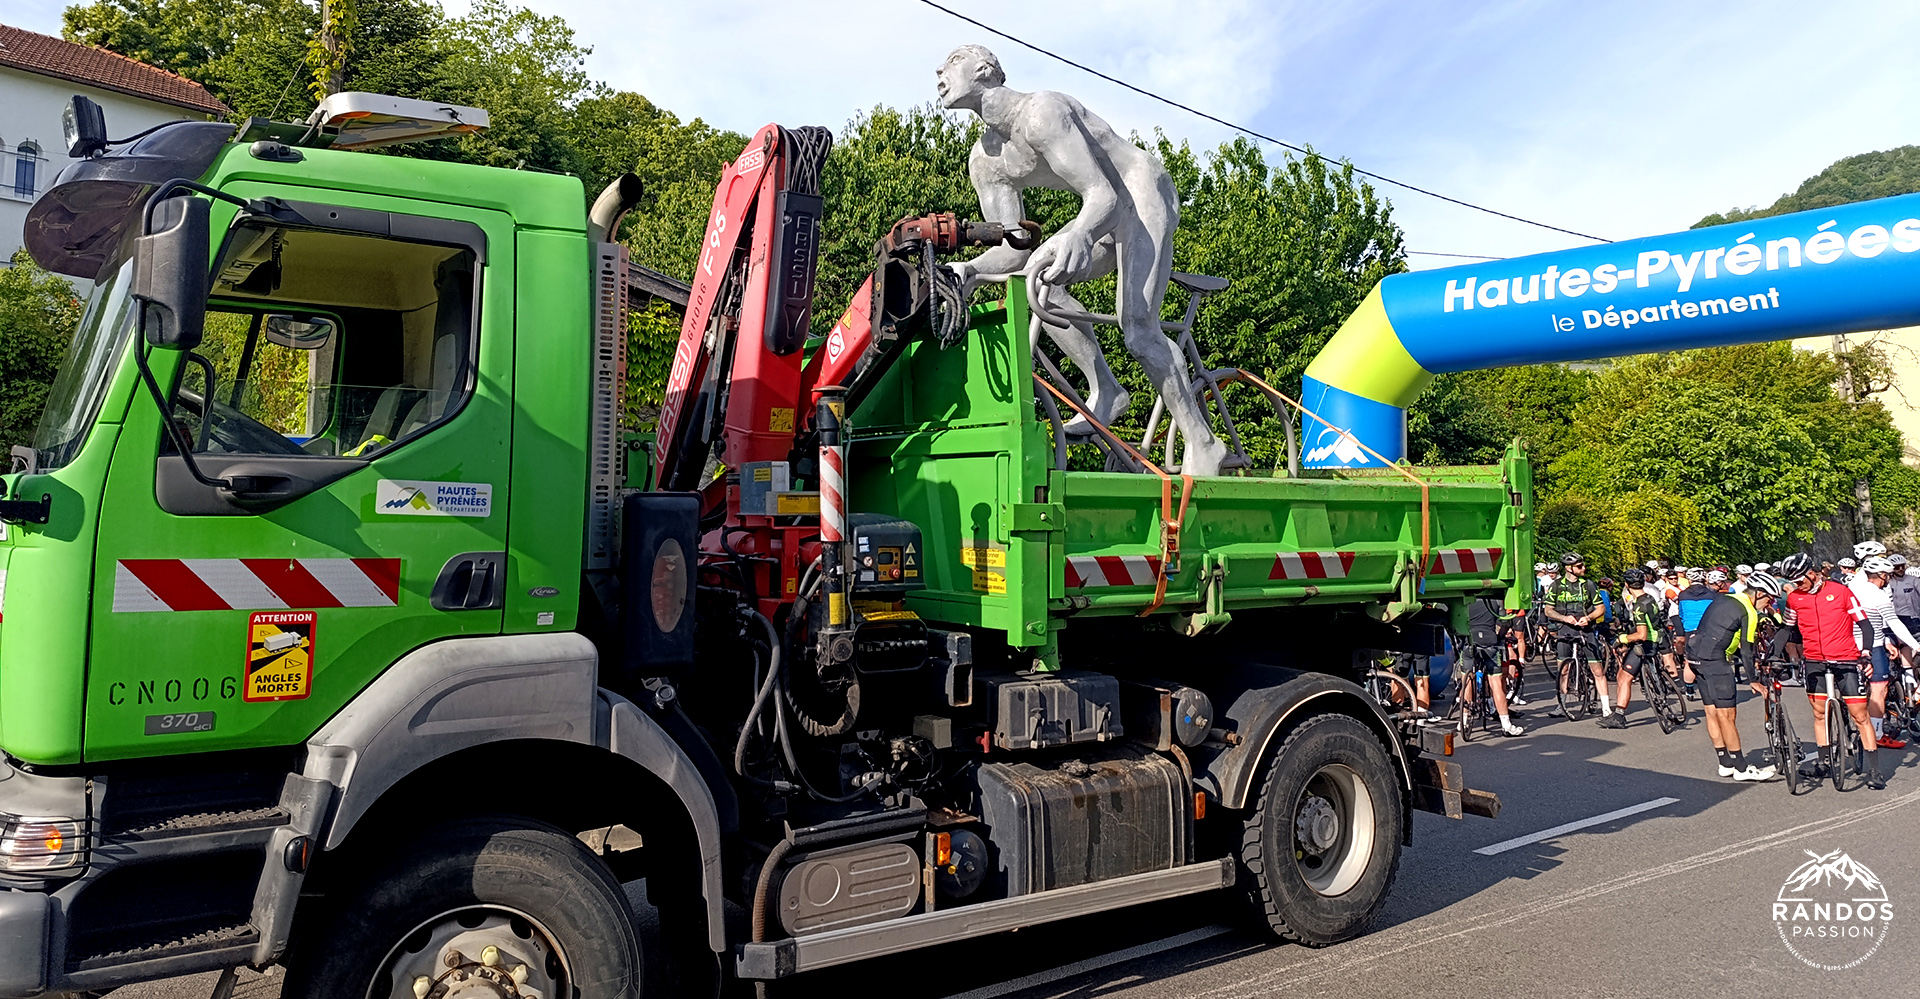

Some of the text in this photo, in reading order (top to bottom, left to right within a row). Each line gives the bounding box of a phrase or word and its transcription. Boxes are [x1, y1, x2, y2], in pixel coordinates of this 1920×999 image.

[740, 152, 762, 171] FASSI
[703, 209, 726, 277] F 95
[791, 215, 809, 295] FASSI
[1443, 218, 1920, 313] Hautes-Pyrénées
[1552, 287, 1780, 332] le Département
[656, 346, 688, 455] FASSI
[253, 613, 313, 623] ATTENTION
[254, 673, 302, 684] ANGLES
[256, 683, 299, 694] MORTS
[160, 713, 199, 729] 370
